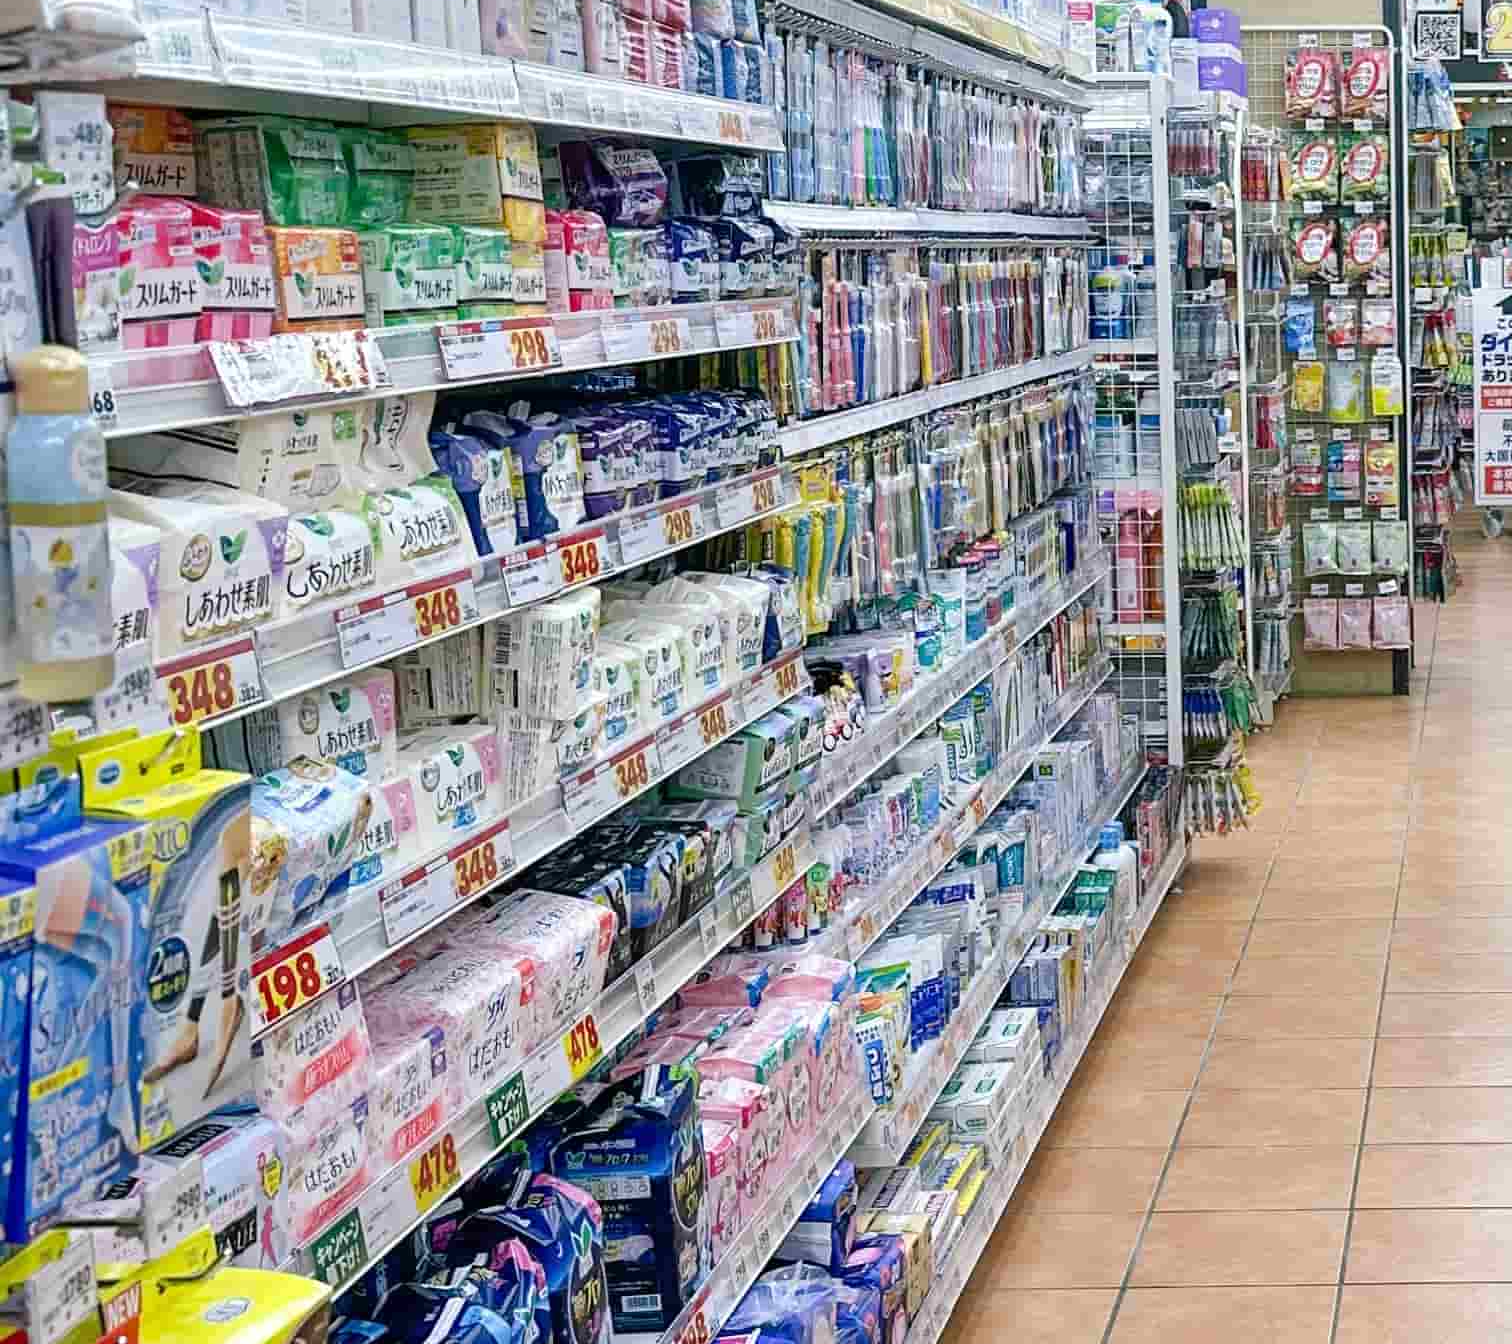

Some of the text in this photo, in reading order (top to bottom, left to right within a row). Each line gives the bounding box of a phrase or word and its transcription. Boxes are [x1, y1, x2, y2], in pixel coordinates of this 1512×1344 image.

[120, 162, 186, 186] スリムガード
[137, 279, 196, 307] スリムガード
[226, 277, 272, 299] スリムガード
[314, 286, 356, 307] スリムガード
[652, 320, 679, 352] 298
[753, 310, 775, 338] 298
[511, 329, 548, 368] 298
[753, 479, 775, 509] 298
[664, 510, 692, 539] 298
[287, 545, 373, 599] しあわせ素肌
[562, 543, 599, 582] 348
[184, 577, 270, 627] しあわせ素肌
[416, 588, 460, 637] 348
[169, 663, 234, 724] 348
[777, 664, 798, 696] 348
[702, 707, 727, 744] 348
[616, 752, 648, 796] 348
[455, 841, 498, 898] 348
[256, 952, 320, 1022] 198
[568, 1015, 597, 1068] 478
[416, 1134, 457, 1197] 478
[104, 1285, 139, 1331] NEW
